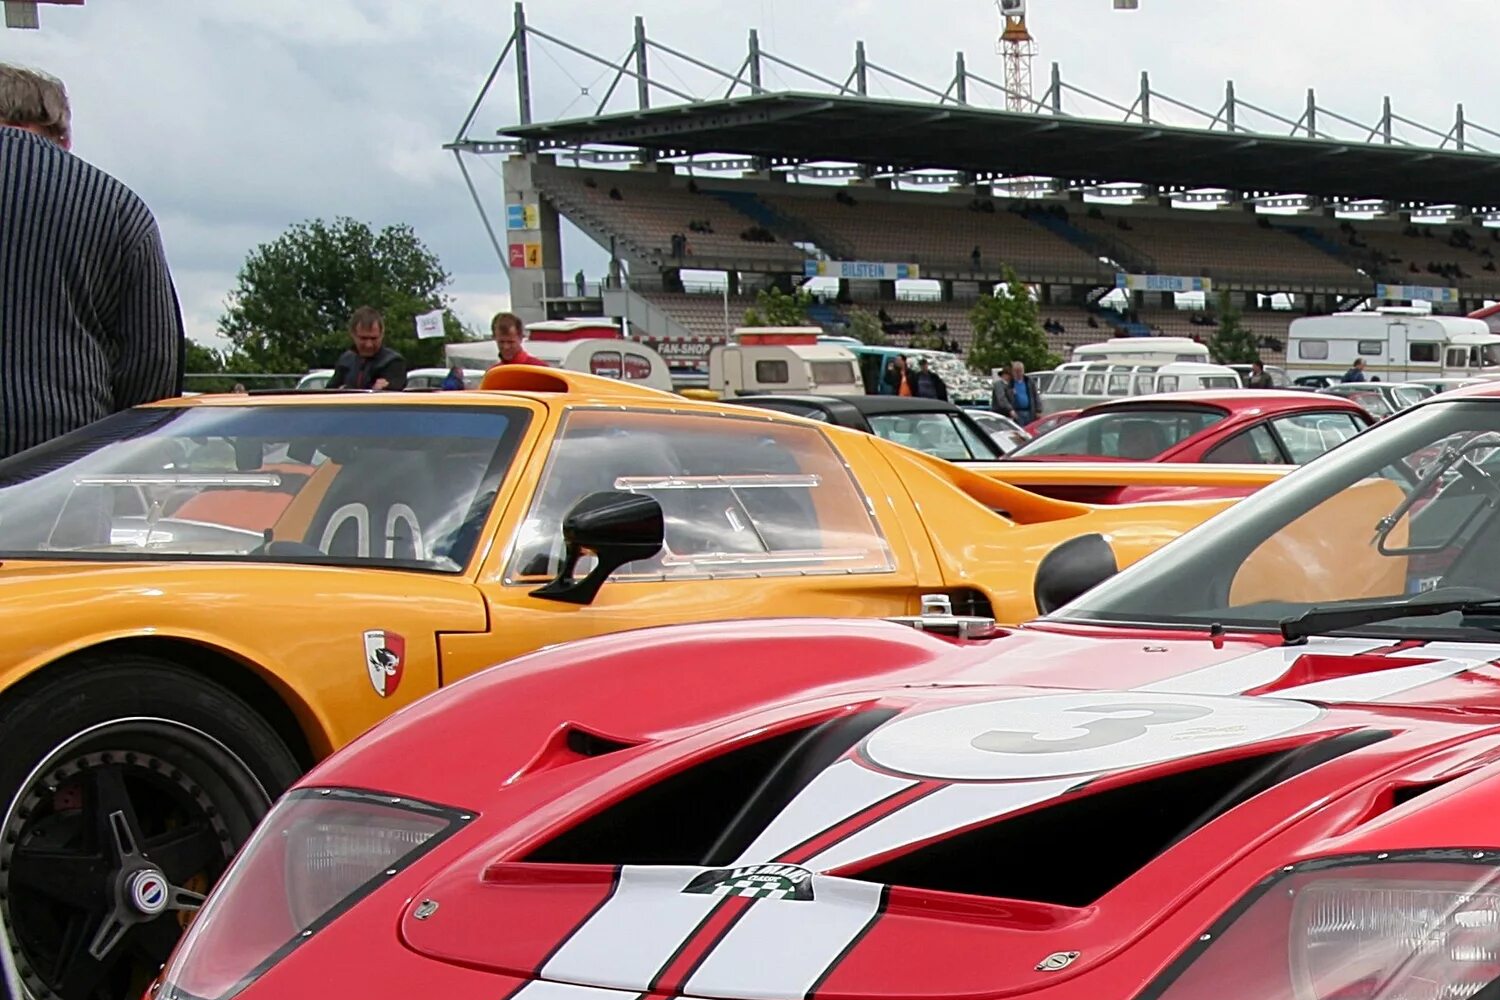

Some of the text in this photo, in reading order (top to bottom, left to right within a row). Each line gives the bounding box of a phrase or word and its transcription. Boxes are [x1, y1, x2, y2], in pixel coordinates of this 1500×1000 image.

[529, 248, 538, 265] 4
[841, 263, 885, 278] BILSTEIN
[657, 343, 711, 355] FAN-SHOP
[970, 702, 1215, 754] 3
[731, 866, 760, 879] LE
